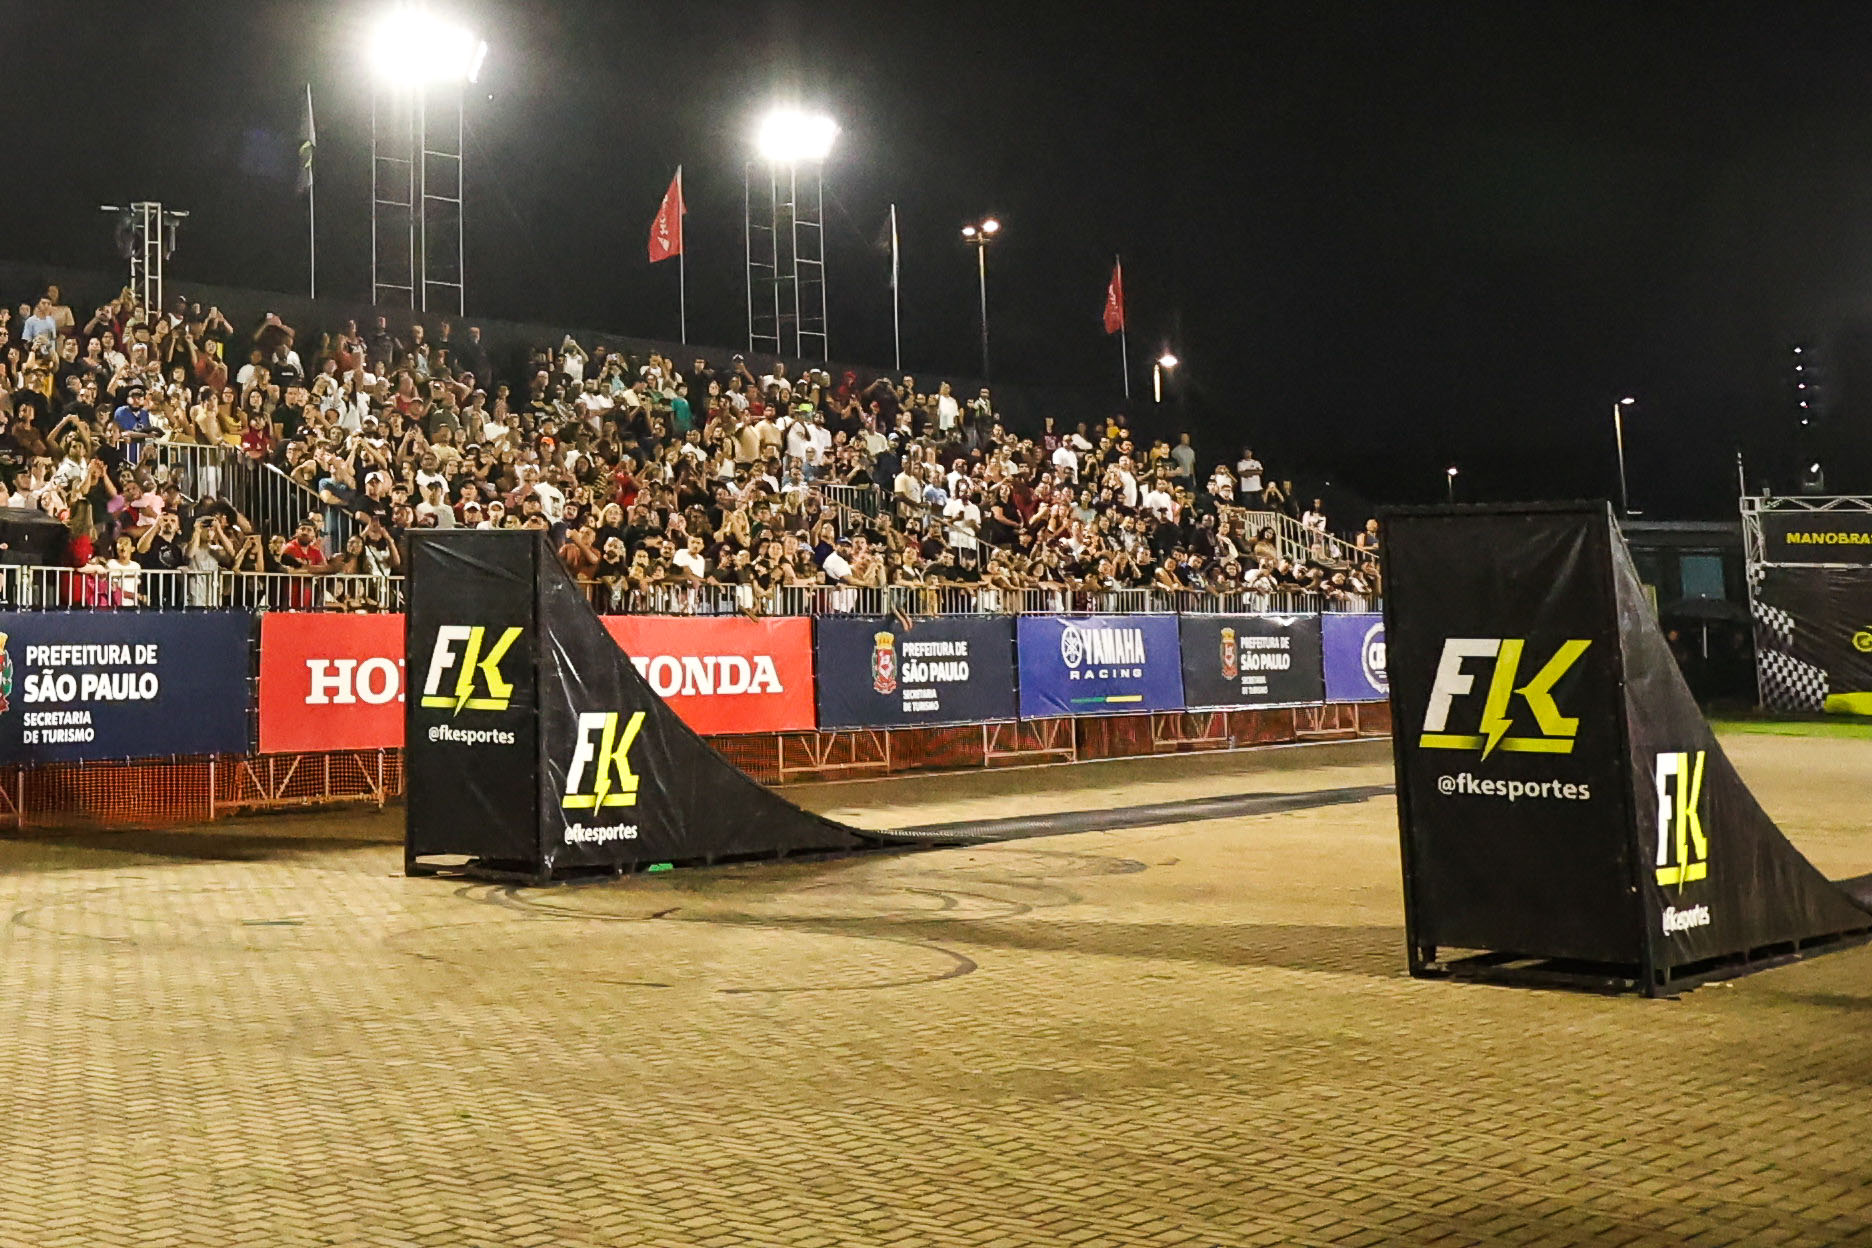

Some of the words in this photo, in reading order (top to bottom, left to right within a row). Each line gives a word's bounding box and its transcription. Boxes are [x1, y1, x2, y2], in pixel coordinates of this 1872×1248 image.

[1786, 532, 1872, 544] MANOBRA
[26, 645, 132, 666] PREFEITURA
[135, 644, 158, 665] DE
[902, 641, 954, 657] PREFEITURA
[955, 641, 968, 656] DE
[1080, 628, 1146, 665] YAMAHA
[1369, 643, 1386, 670] CB
[423, 625, 524, 718] FK
[902, 659, 929, 683] SÃO
[930, 661, 969, 682] PAULO
[1069, 668, 1143, 680] RACING
[1260, 653, 1290, 670] PAULO
[24, 668, 77, 702] SÃO
[81, 672, 159, 701] PAULO
[305, 657, 405, 704] HO
[1422, 638, 1593, 762] FK
[24, 711, 92, 726] SECRETARIA
[24, 730, 39, 743] DE
[42, 728, 95, 743] TURISMO
[428, 724, 515, 746] @fkesportes
[565, 712, 646, 817] FK
[1438, 773, 1590, 802] @fkesportes
[1656, 751, 1708, 896] FK
